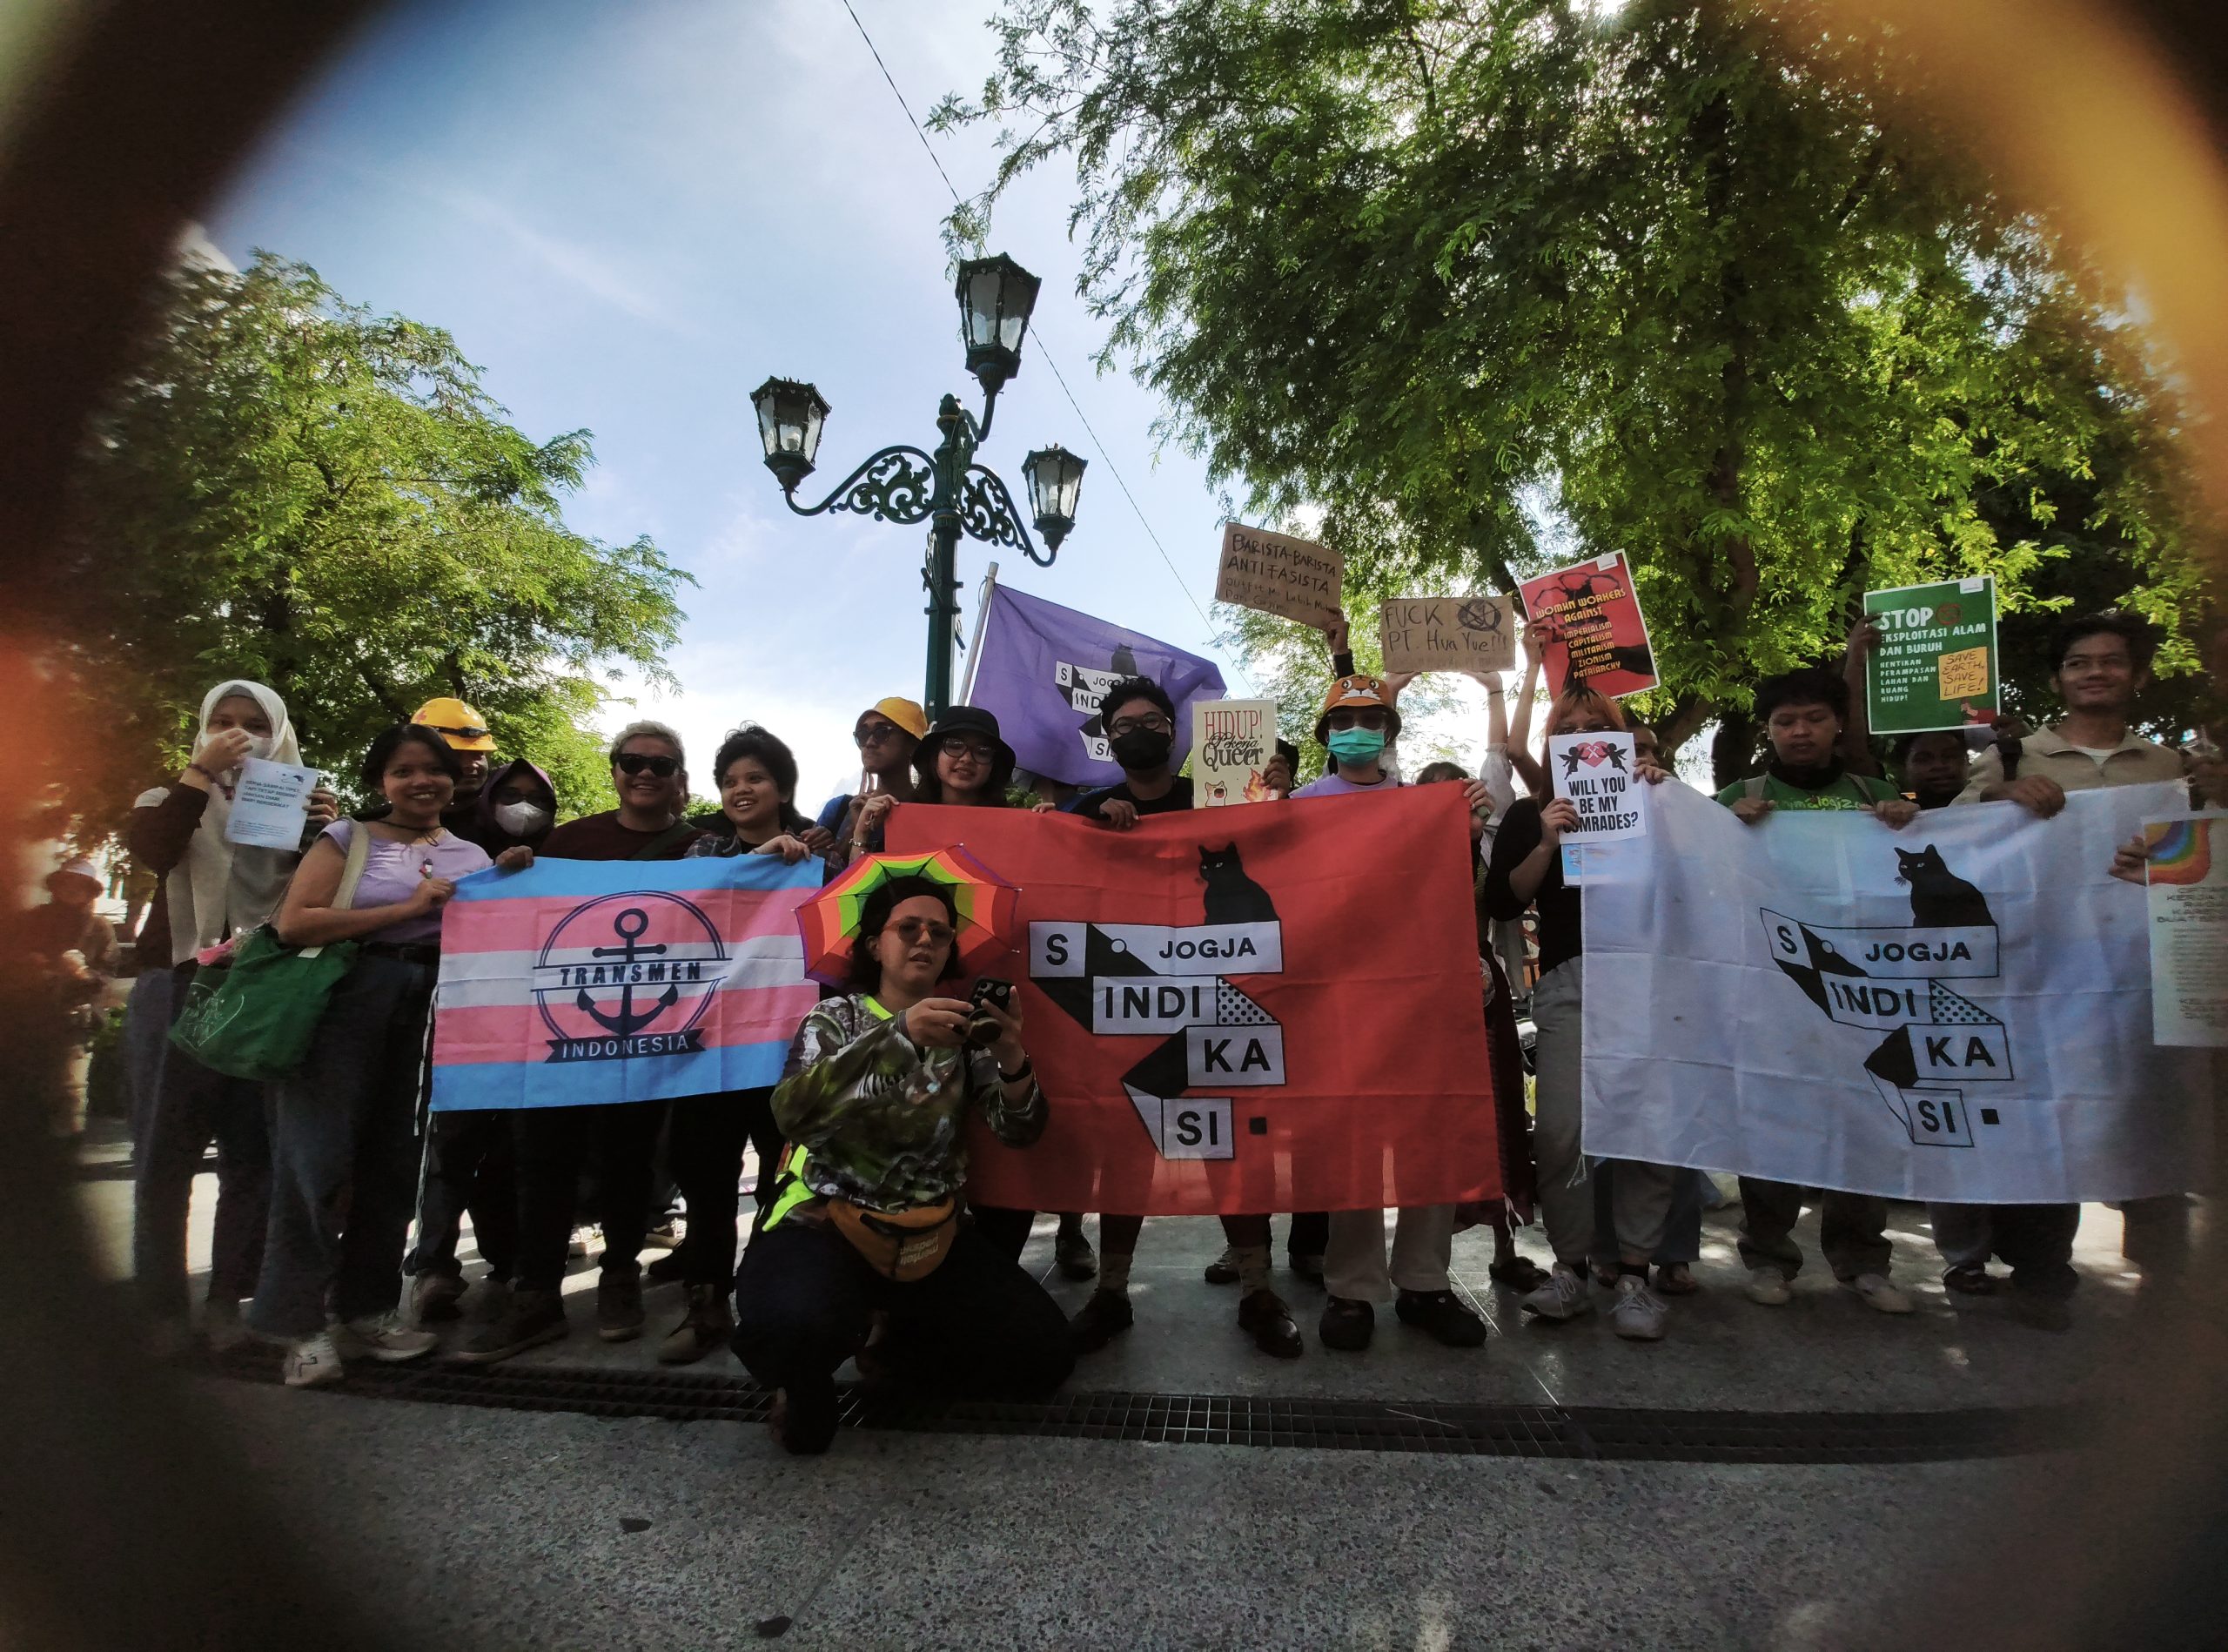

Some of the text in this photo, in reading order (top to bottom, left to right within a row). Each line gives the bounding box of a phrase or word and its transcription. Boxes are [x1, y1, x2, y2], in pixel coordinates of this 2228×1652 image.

[1232, 534, 1336, 577] BARISTA-BARISTA
[1578, 588, 1627, 607] WORKERS
[1385, 604, 1443, 628] FUCK
[1564, 606, 1603, 623] AGAINST
[1878, 607, 1934, 631] STOP
[1564, 621, 1613, 640] IMPERIALISM
[1952, 622, 1987, 636] ALAM
[1427, 630, 1458, 652] Hua
[1462, 632, 1507, 652] Yue!!!
[1568, 631, 1613, 648] CAPITALISM
[1880, 641, 1943, 657] DAN BURUH
[1571, 641, 1615, 659] MILITARISM
[1947, 651, 1977, 665] SAVE
[1574, 661, 1621, 679] PATRIARCHY
[1578, 653, 1613, 668] ZIONISM
[1880, 659, 1922, 669] HENTIKAN
[1880, 666, 1936, 677] PERAMPASAN
[1944, 672, 1976, 684] SAVE
[1881, 677, 1908, 686] LAHAN
[1881, 686, 1909, 695] RUANG
[1944, 677, 1983, 696] LIFE!
[1076, 693, 1101, 708] IND
[1881, 694, 1908, 702] HIDUP!
[1205, 709, 1263, 741] HIDUP!
[1203, 742, 1264, 772] Queer
[1568, 776, 1626, 796] WILL YOU
[1579, 796, 1618, 814] BE MY
[1158, 937, 1258, 959] JOGJA
[1865, 942, 1972, 962] JOGJA
[560, 962, 701, 986] TRANSMEN
[1104, 985, 1201, 1019] INDI
[1829, 981, 1917, 1017] INDI
[562, 1034, 689, 1058] INDONESIA
[1204, 1038, 1272, 1072] KA
[1925, 1036, 1996, 1068] KA
[1917, 1100, 1956, 1133] SI
[1176, 1111, 1218, 1146] SI
